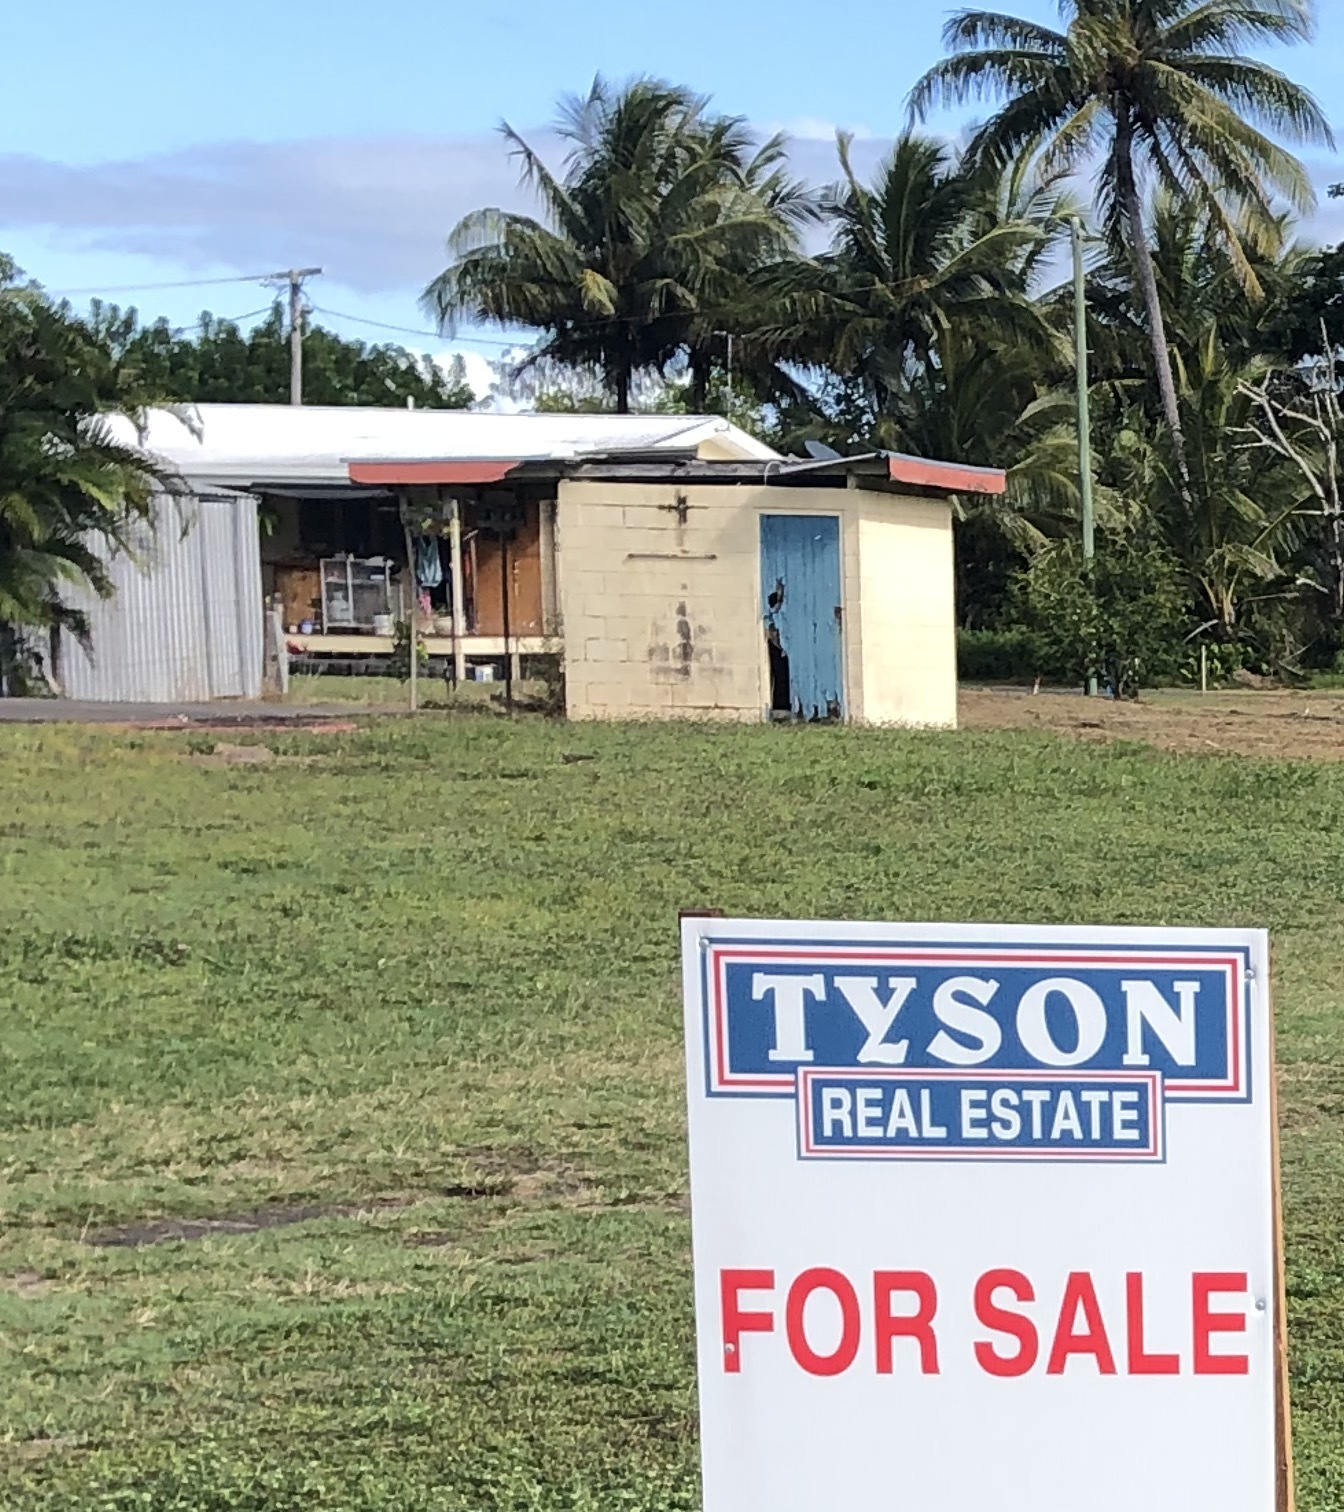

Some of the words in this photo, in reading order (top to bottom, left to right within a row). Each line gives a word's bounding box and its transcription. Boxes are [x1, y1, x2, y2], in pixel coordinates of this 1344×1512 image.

[752, 972, 1201, 1067] TYSON
[822, 1088, 946, 1139] REAL
[961, 1088, 1141, 1141] ESTATE
[720, 1267, 940, 1375] FOR
[973, 1267, 1249, 1378] SALE
